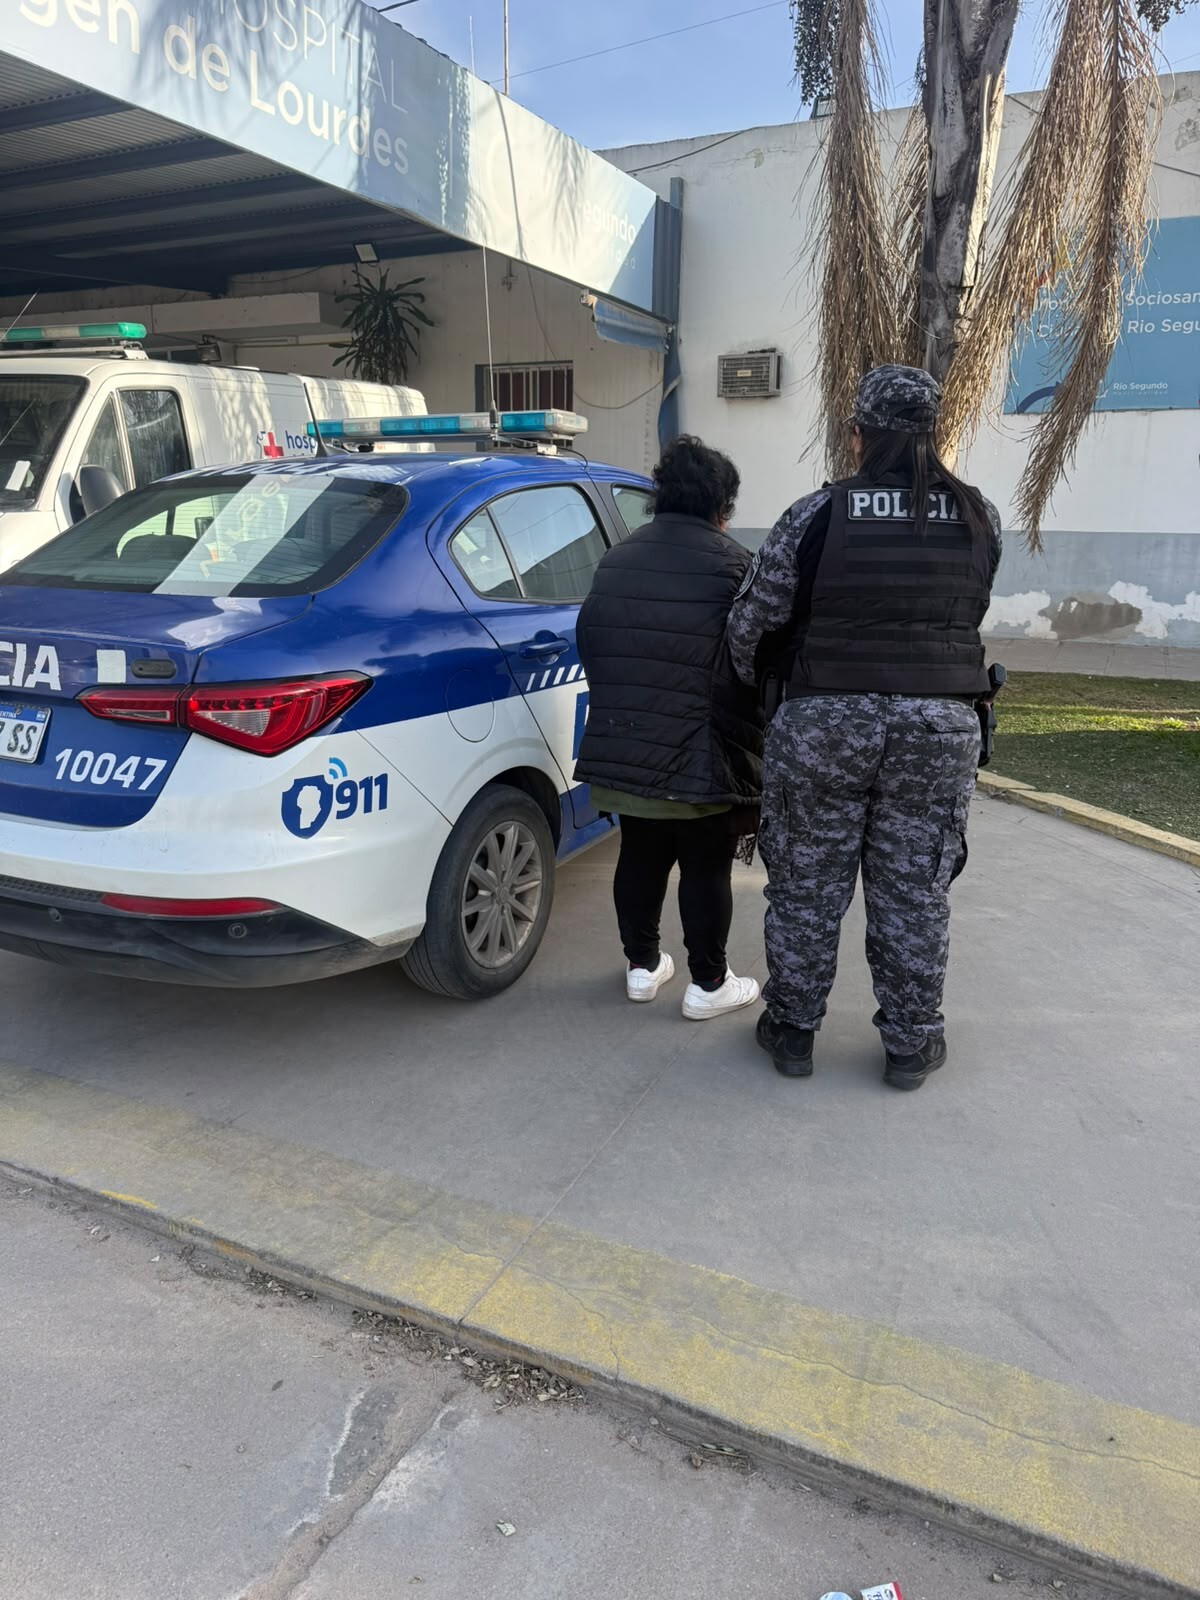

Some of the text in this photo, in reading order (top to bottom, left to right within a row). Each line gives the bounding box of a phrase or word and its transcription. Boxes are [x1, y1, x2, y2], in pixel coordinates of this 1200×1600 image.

[219, 0, 409, 114] OSPITAL
[163, 15, 230, 92] de
[249, 49, 408, 175] Lourdes
[579, 198, 636, 244] egundo
[1130, 381, 1168, 391] Segundo
[852, 491, 960, 520] POLCI
[6, 723, 38, 755] SS
[55, 748, 167, 791] 10047
[335, 772, 389, 820] 911
